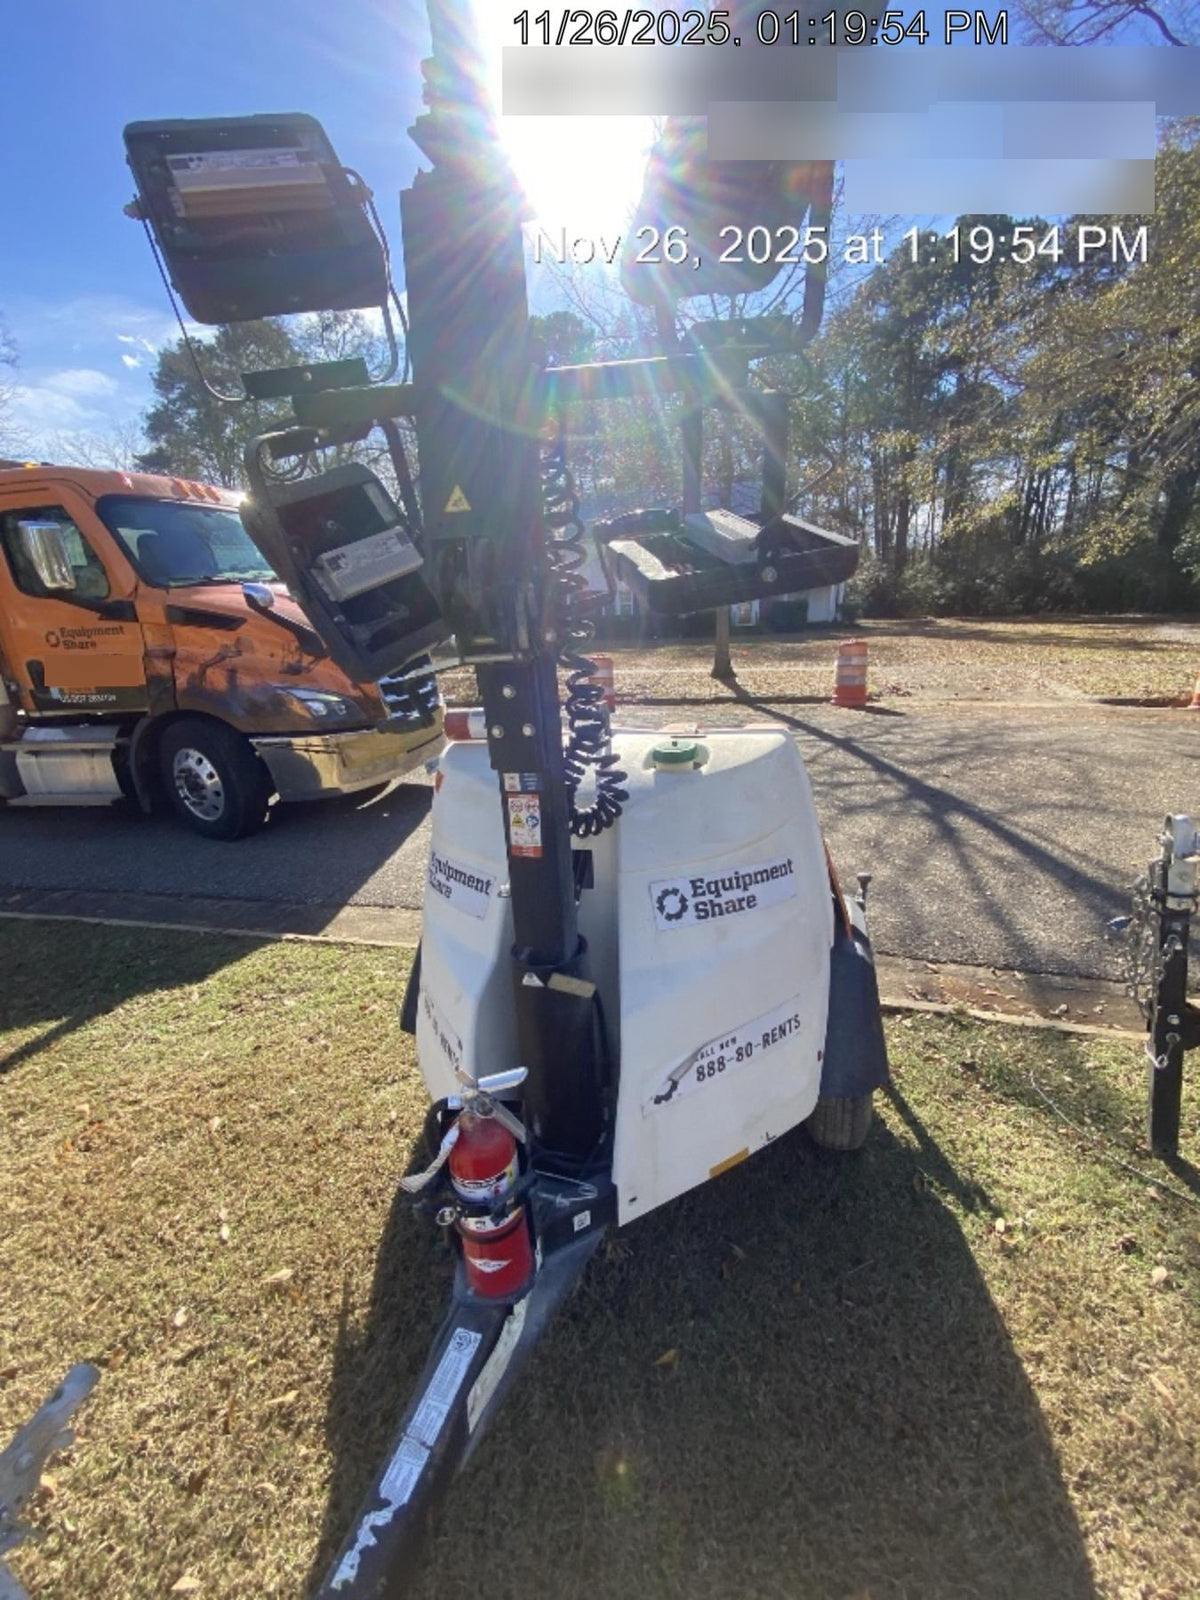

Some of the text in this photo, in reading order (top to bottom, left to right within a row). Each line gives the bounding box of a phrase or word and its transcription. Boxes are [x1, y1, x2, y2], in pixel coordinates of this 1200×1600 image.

[60, 625, 125, 639] Equipment
[63, 640, 96, 649] Share
[690, 858, 793, 899] Equipment
[694, 894, 757, 920] Share
[696, 1014, 801, 1082] 888-80-RENTS
